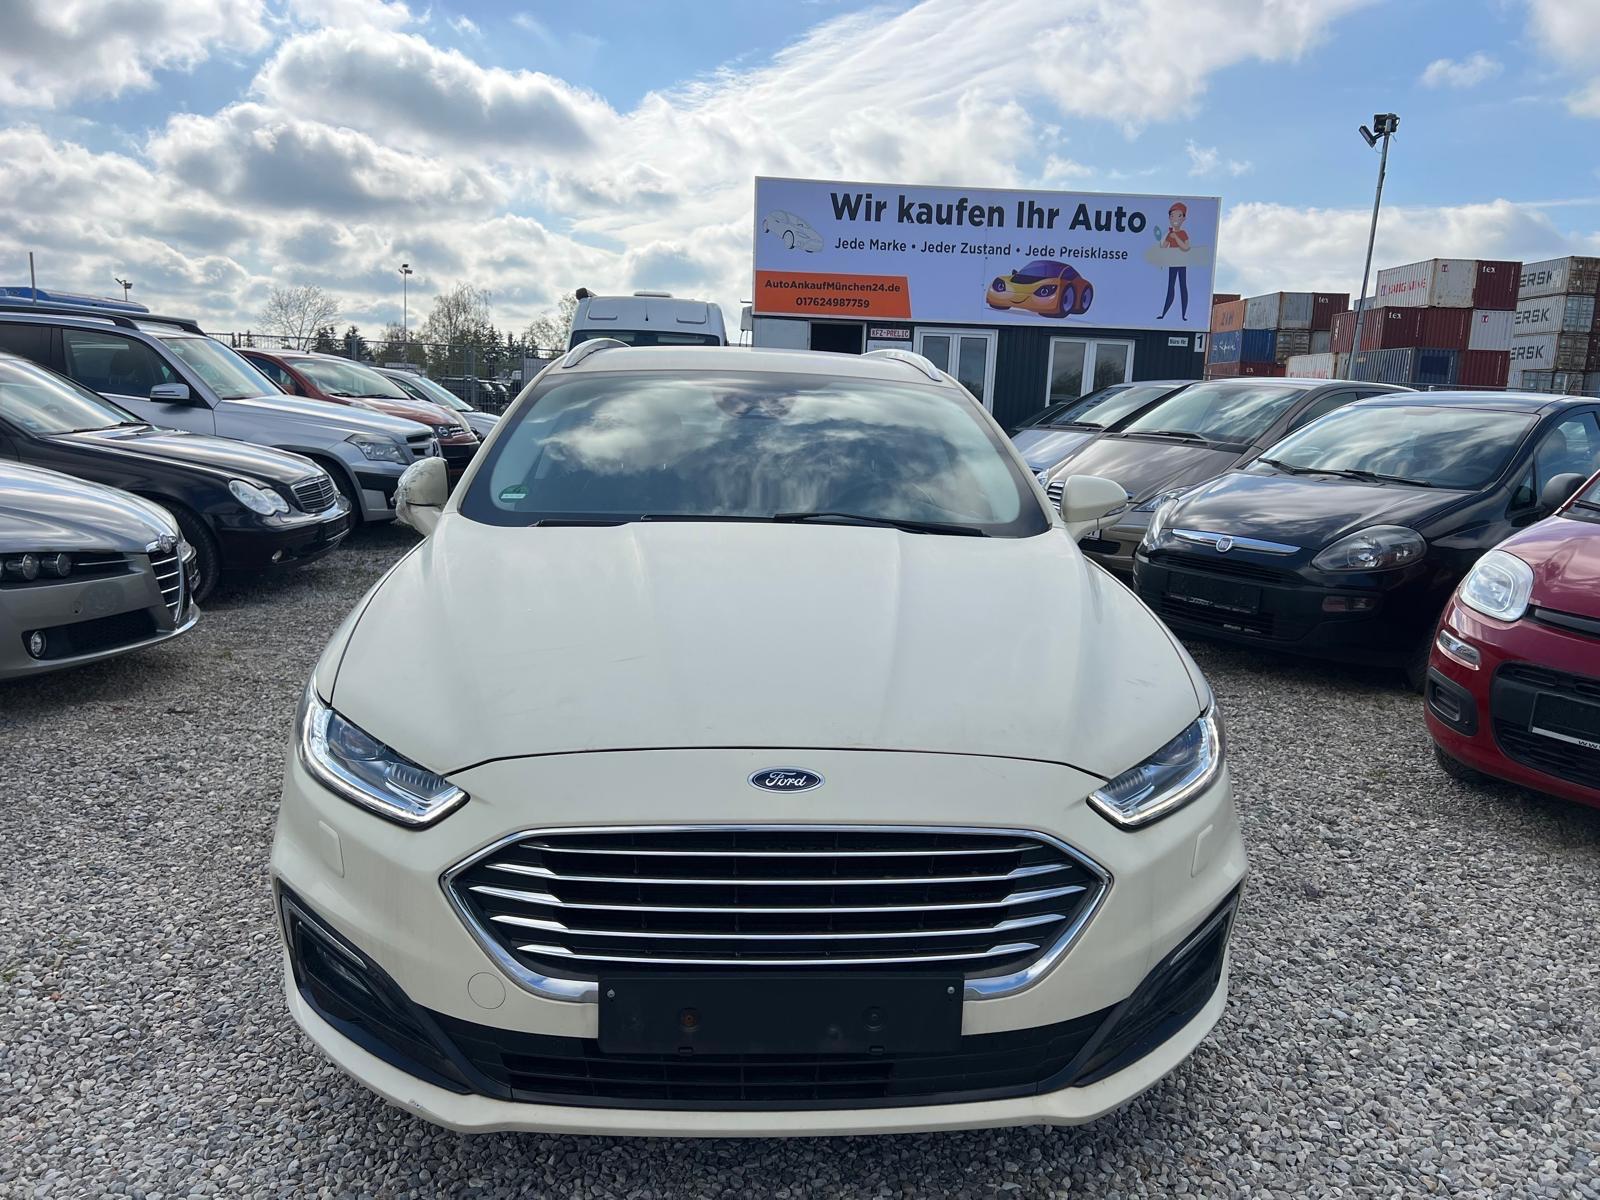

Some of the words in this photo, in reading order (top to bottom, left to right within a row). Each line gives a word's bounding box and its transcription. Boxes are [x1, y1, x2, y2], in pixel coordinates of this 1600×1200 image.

[830, 192, 887, 222] Wir
[898, 194, 1005, 228] kaufen
[1017, 200, 1060, 230] Ihr
[1069, 203, 1147, 233] Auto
[835, 238, 865, 250] Jede
[869, 239, 907, 252] Marke
[920, 241, 957, 254] Jeder
[960, 243, 1011, 256] Zustand
[1025, 245, 1056, 257] Jede
[1059, 246, 1129, 260] Preisklasse
[765, 279, 901, 293] AutoAnkaufMünchen24.de
[795, 297, 870, 308] 017624987759
[1197, 334, 1204, 349] 1
[765, 771, 807, 786] Ford
